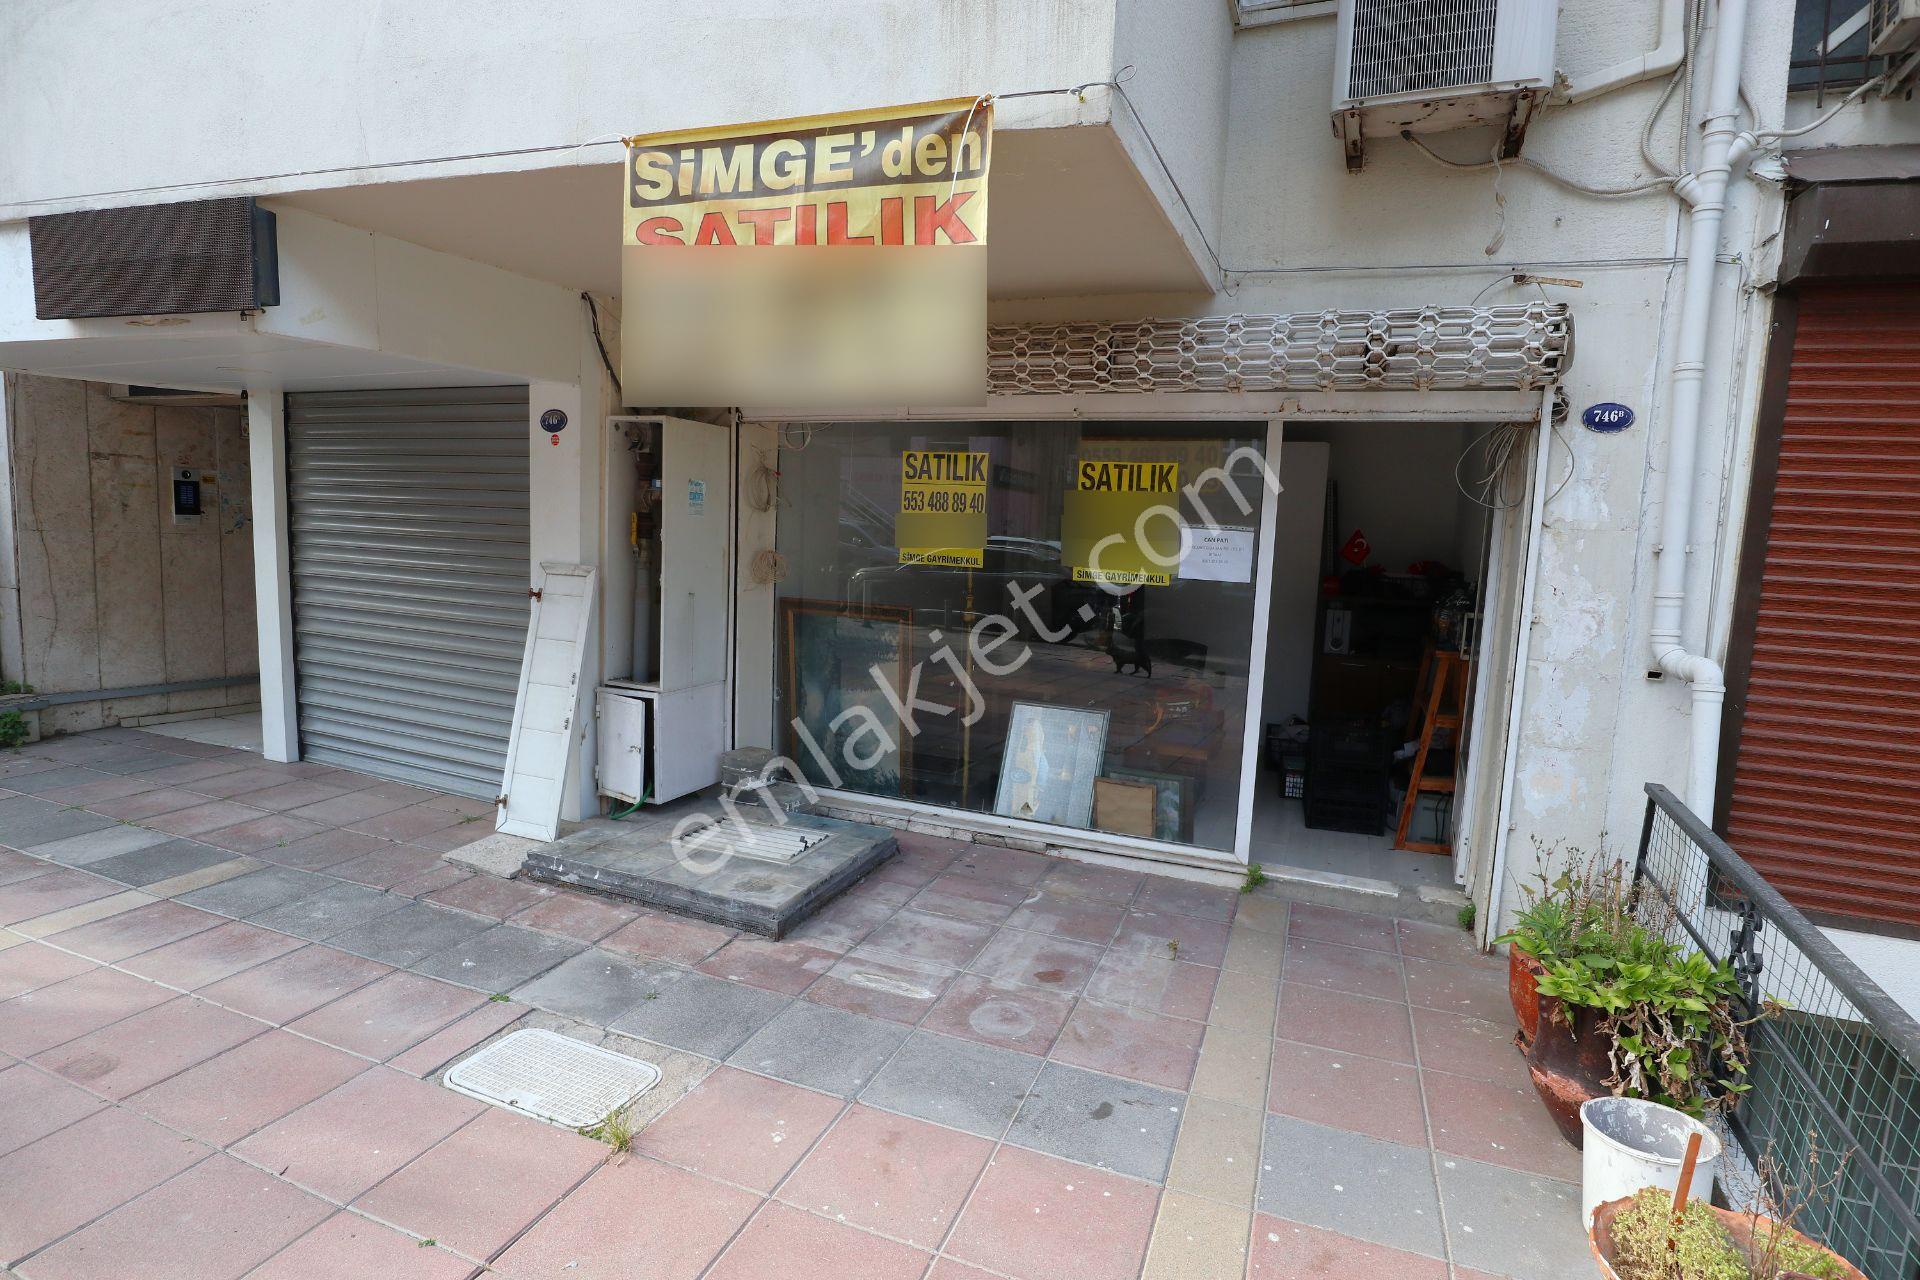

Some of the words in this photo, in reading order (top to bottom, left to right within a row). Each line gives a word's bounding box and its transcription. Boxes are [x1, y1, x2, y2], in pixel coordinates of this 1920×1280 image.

[905, 453, 986, 481] SATILIK
[1081, 463, 1175, 492] SATILIK
[904, 491, 925, 511] 553
[928, 491, 949, 512] 488
[952, 492, 967, 512] 89
[970, 493, 985, 513] 40
